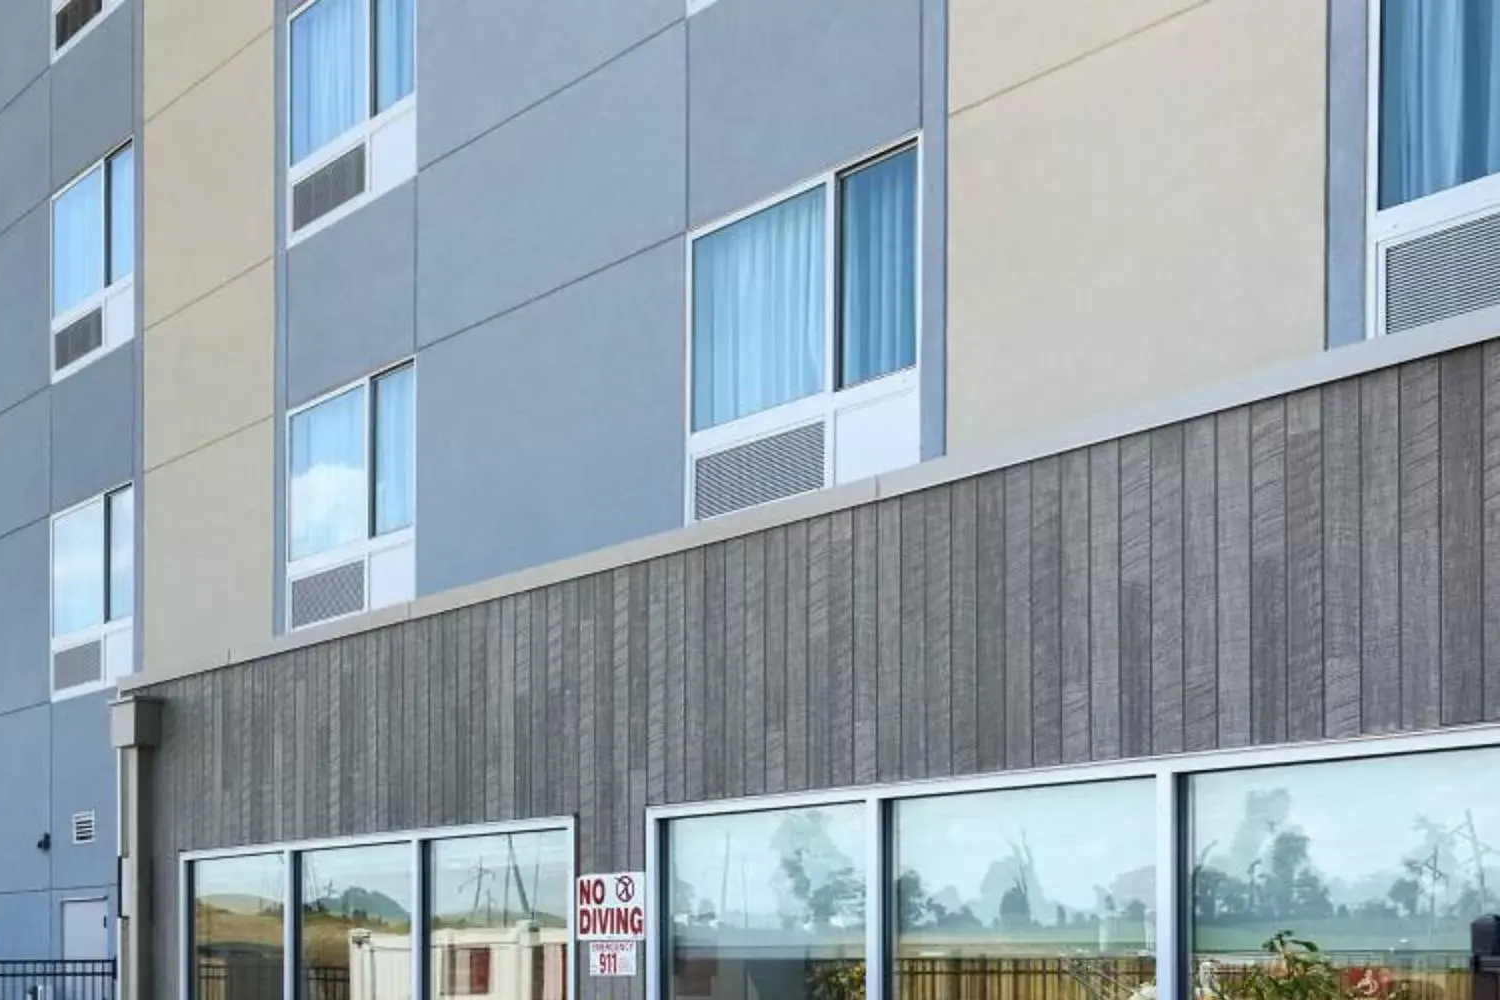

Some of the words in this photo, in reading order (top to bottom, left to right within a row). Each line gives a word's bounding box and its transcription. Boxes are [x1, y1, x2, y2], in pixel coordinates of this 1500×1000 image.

[580, 879, 605, 904] NO
[579, 907, 643, 935] DIVING
[599, 953, 617, 973] 911
